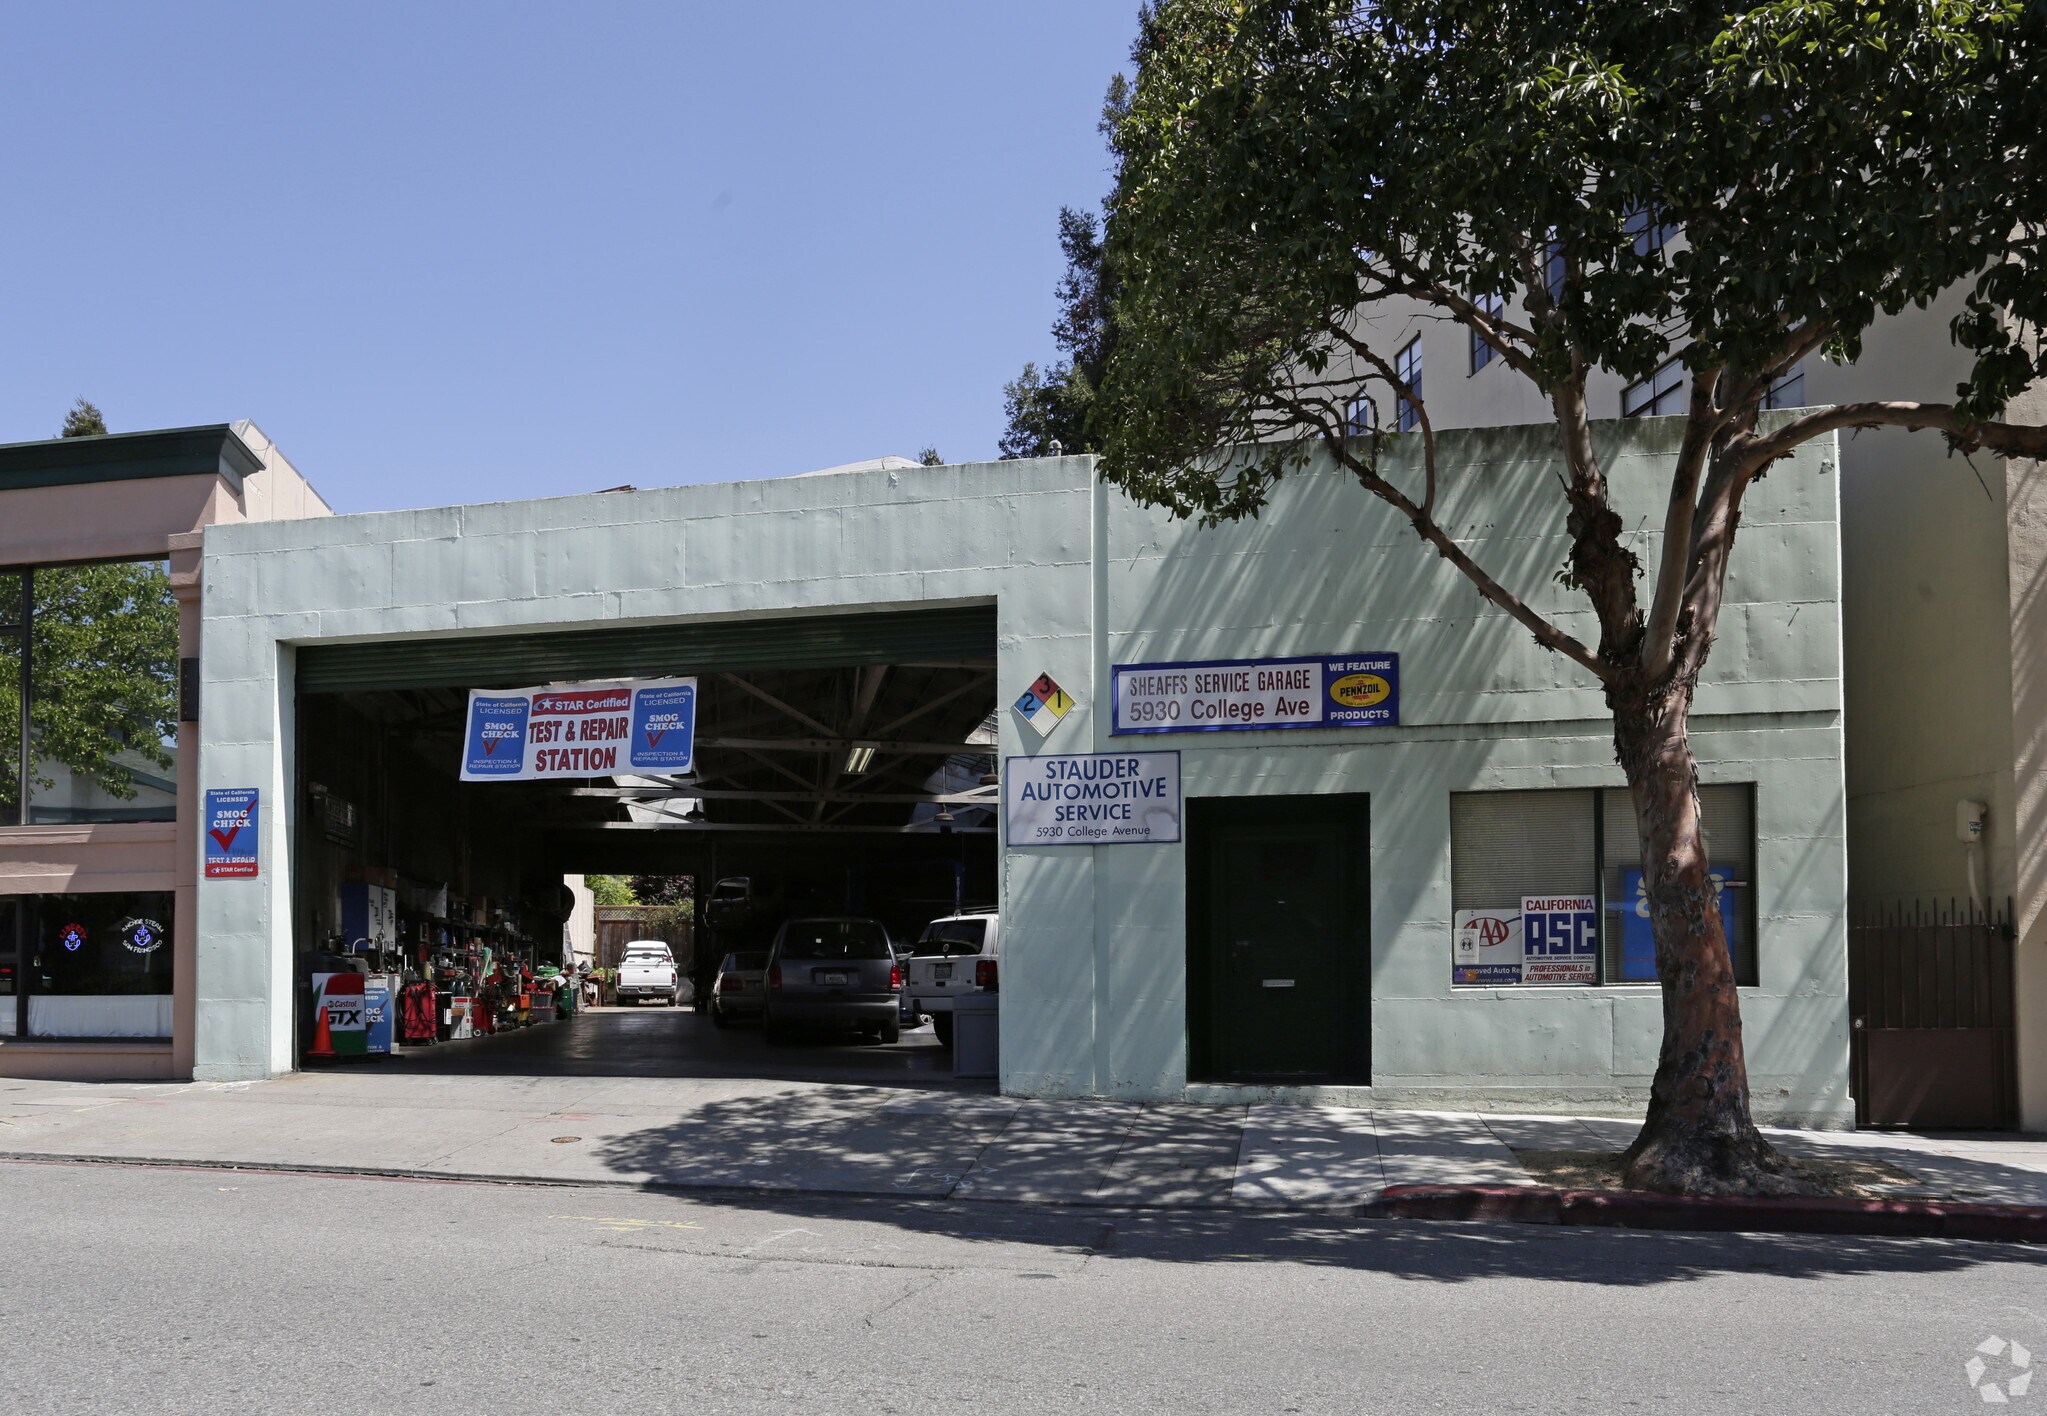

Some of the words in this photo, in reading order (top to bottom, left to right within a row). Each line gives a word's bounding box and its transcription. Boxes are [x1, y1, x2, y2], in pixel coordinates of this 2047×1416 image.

[1328, 663, 1345, 672] WE
[1346, 661, 1391, 671] FEATURE
[1039, 674, 1051, 694] 3
[1129, 674, 1188, 697] SHEAFFS
[1195, 672, 1250, 694] SERVICE
[1258, 669, 1311, 691] GARAGE
[1340, 683, 1381, 698] PENNZOIL
[555, 700, 584, 711] STAR
[586, 697, 628, 710] Certified
[644, 697, 685, 706] LICENSED
[1022, 692, 1035, 712] 2
[1056, 688, 1062, 708] 1
[1129, 700, 1180, 722] 5930
[1191, 699, 1264, 722] College
[1275, 696, 1310, 717] Ave
[1330, 709, 1389, 720] PRODUCTS
[649, 713, 679, 722] SMOG
[484, 722, 514, 730] SMOG
[529, 720, 562, 744] TEST
[565, 720, 576, 742] &
[579, 716, 629, 741] REPAIR
[644, 721, 684, 731] CHECK
[481, 730, 519, 738] CHECK
[535, 746, 616, 772] STATION
[1046, 758, 1140, 781] STAUDER
[1021, 777, 1166, 801] AUTOMOTIVE
[216, 810, 248, 819] SMOG
[1055, 803, 1131, 822] SERVICE
[213, 819, 252, 828] CHECK
[1036, 827, 1063, 837] 5930
[1067, 826, 1107, 838] College
[1112, 826, 1150, 835] Avenue
[1526, 899, 1593, 911] CALIFORNIA
[59, 923, 87, 940] LIBERTY
[121, 918, 144, 932] ANCHOR
[144, 918, 165, 933] STEAM
[1525, 913, 1596, 955] ASC
[122, 939, 133, 952] SAN
[133, 940, 163, 954] FRANCISCO
[1530, 964, 1583, 973] PROFESSIONALS
[1525, 973, 1567, 981] AUTOMOTIVE
[1568, 972, 1596, 980] SERVICE
[334, 1000, 357, 1008] Castrol
[328, 1010, 362, 1026] GTX
